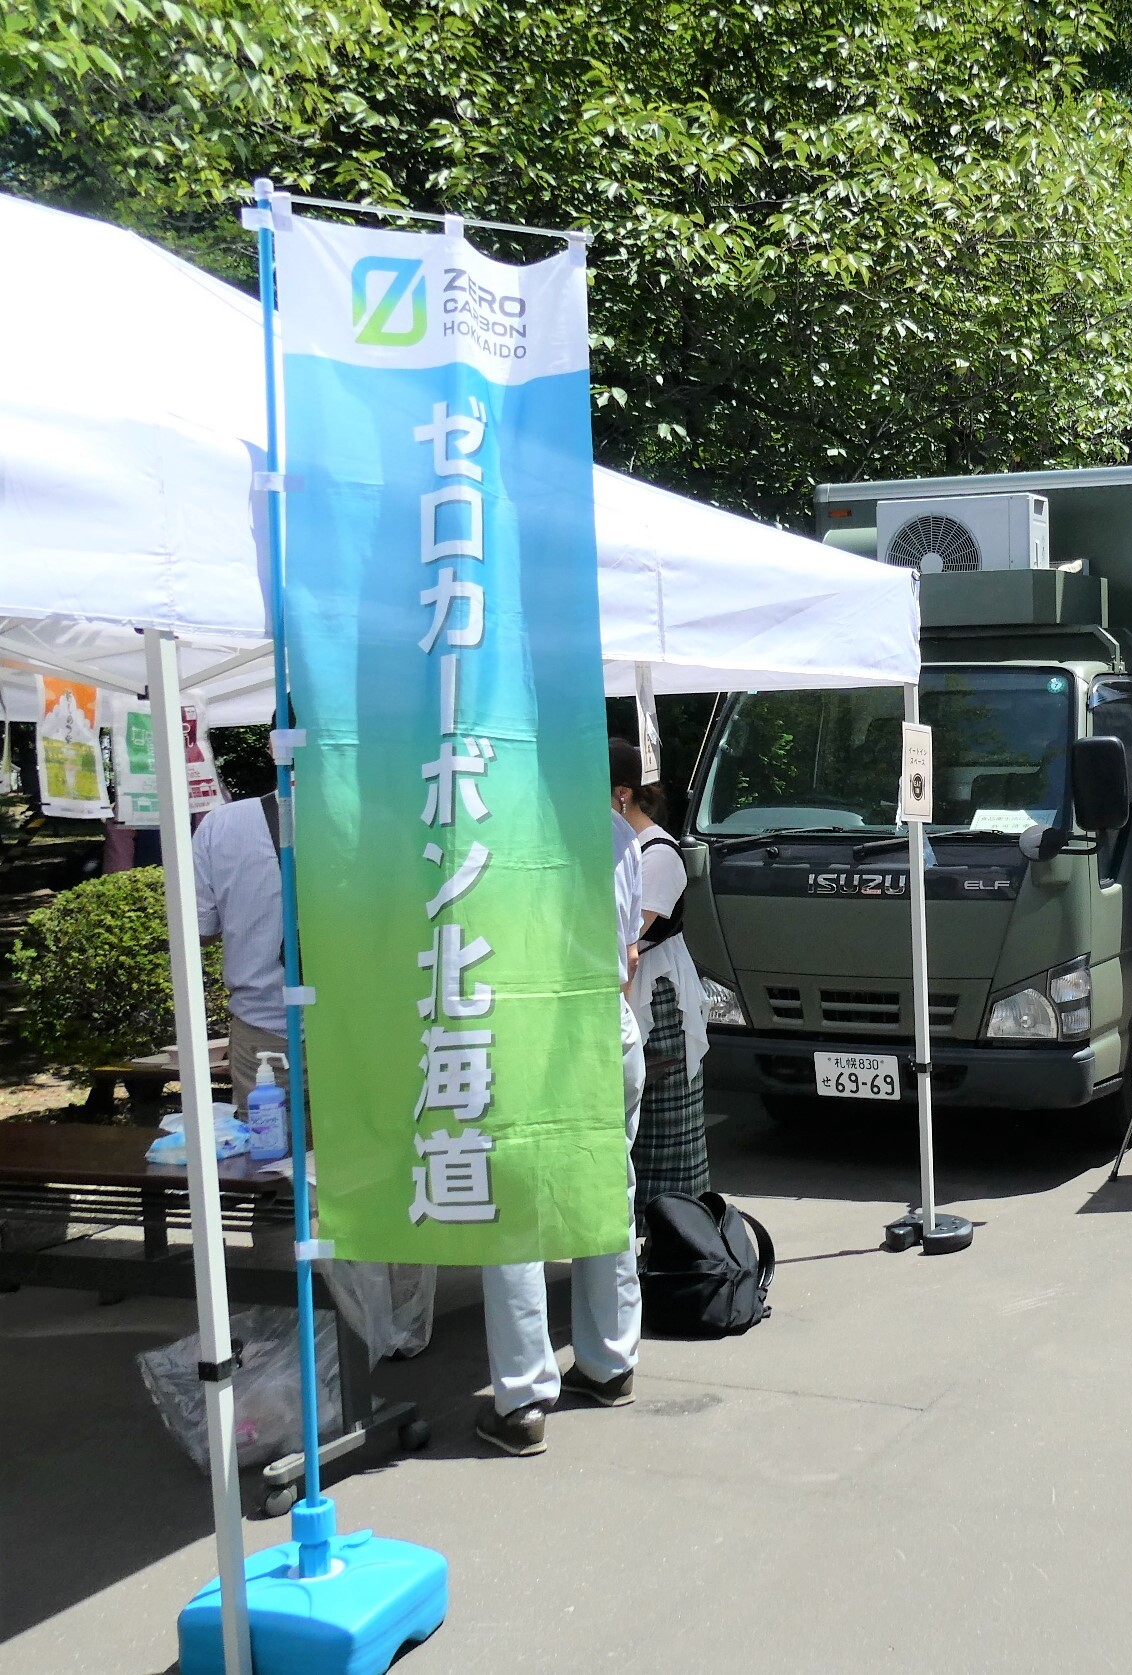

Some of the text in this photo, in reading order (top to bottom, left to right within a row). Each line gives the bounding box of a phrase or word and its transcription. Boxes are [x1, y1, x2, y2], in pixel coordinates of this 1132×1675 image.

[443, 268, 526, 318] ZERO
[443, 298, 527, 338] CARBON
[443, 320, 527, 359] HOKKAIDO
[409, 396, 499, 1224] ゼロカーボン北海道
[808, 873, 906, 895] ISUZU
[964, 880, 1011, 890] ELF
[822, 1072, 895, 1096] せ 69-69
